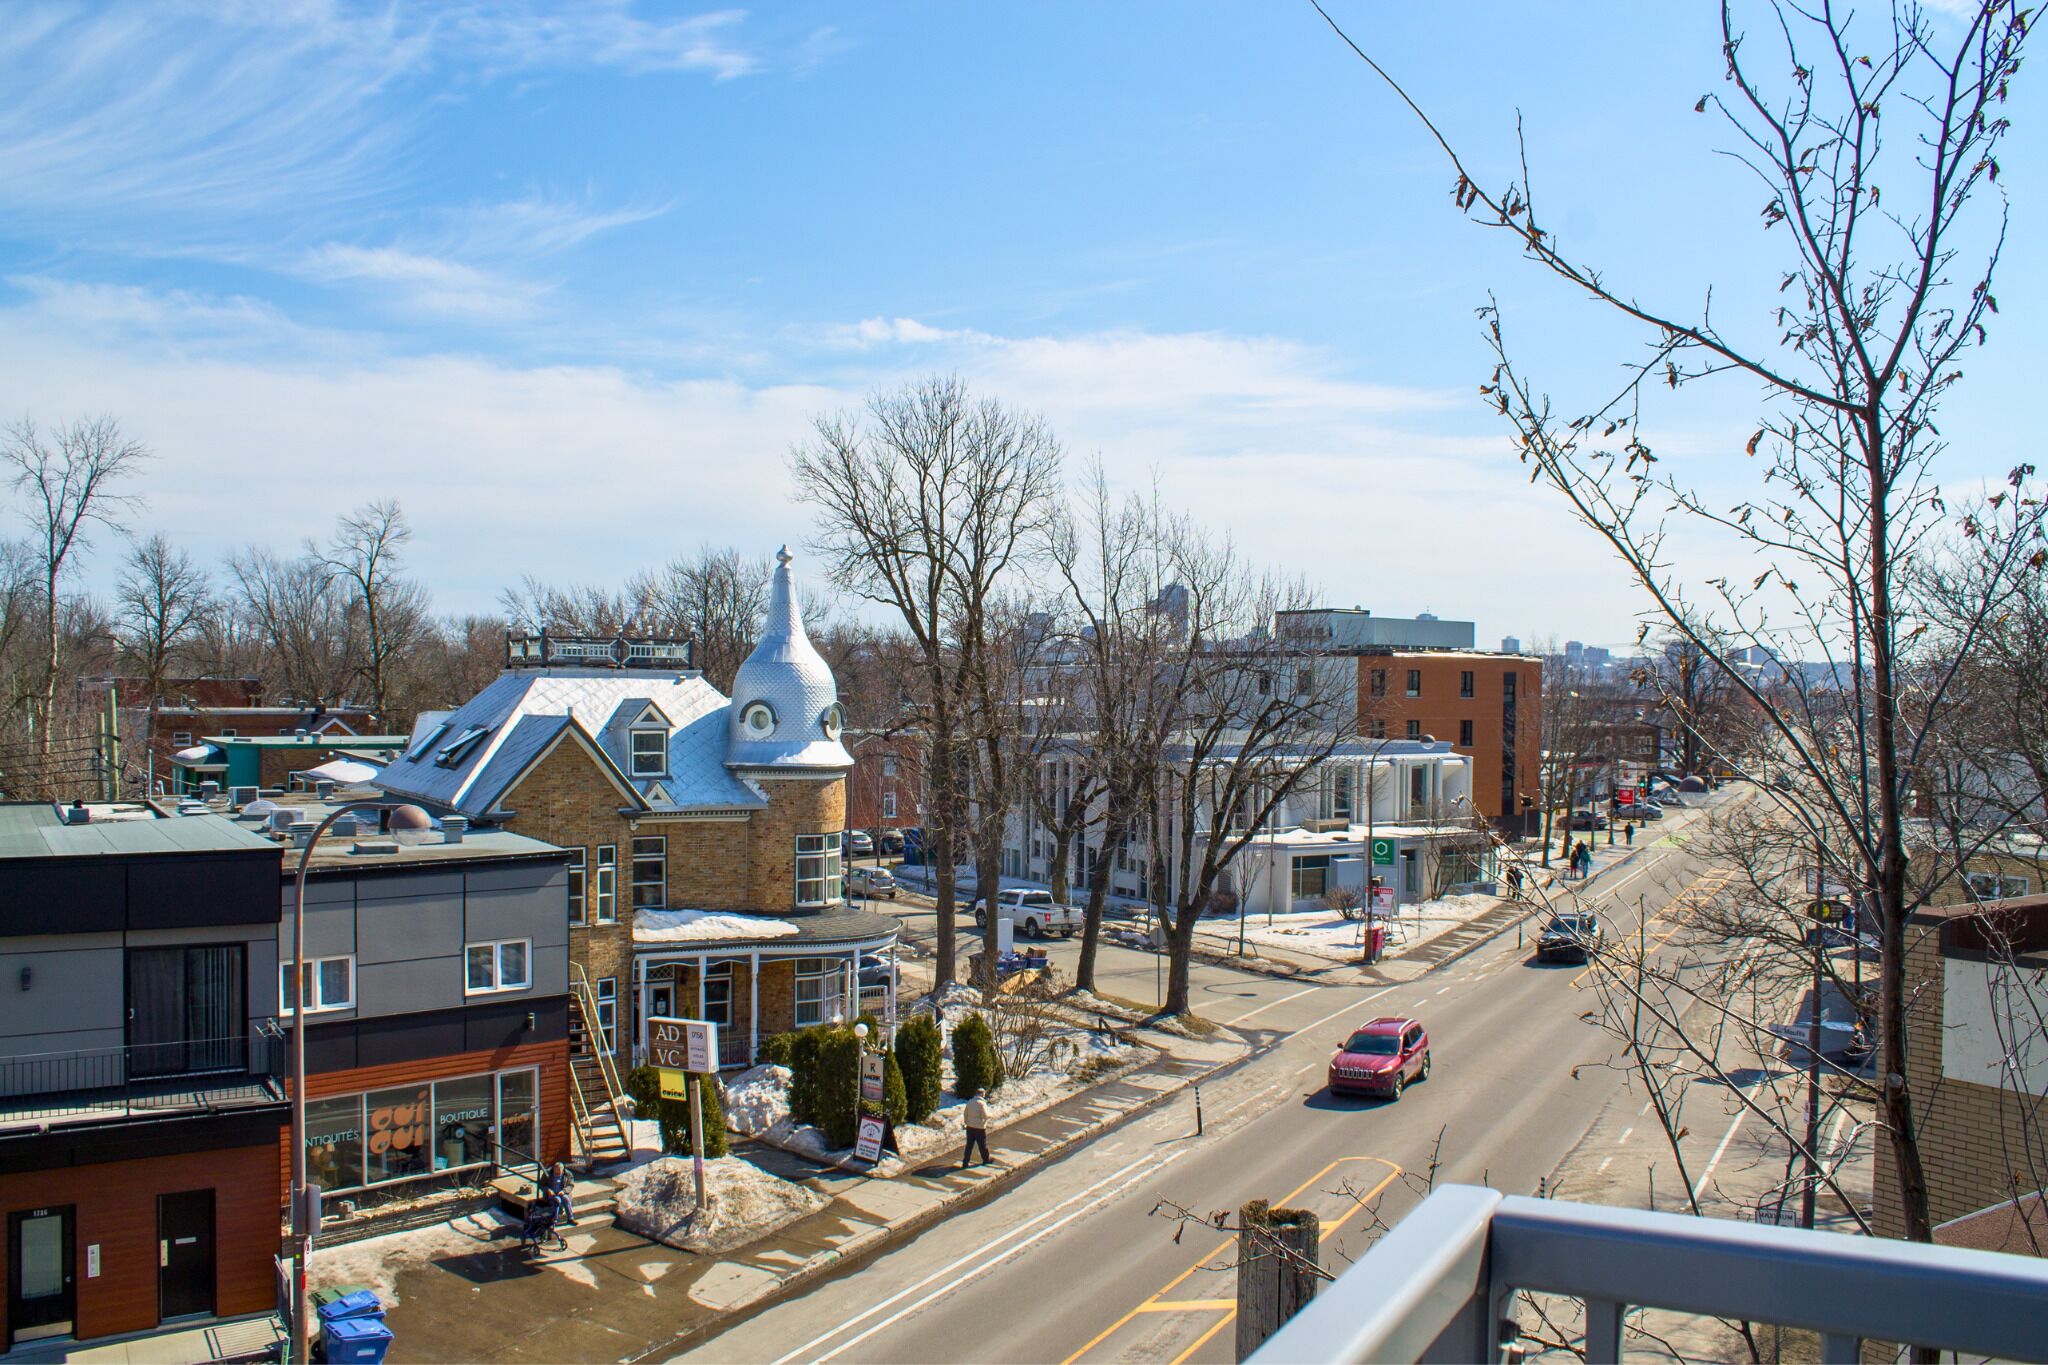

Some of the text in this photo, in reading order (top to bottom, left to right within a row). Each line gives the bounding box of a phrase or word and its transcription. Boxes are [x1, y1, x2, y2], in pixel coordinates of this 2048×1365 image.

[656, 1024, 680, 1042] AD
[656, 1048, 680, 1067] VC
[370, 1090, 428, 1130] oui
[440, 1107, 488, 1124] BOUTIQUE
[304, 1129, 360, 1147] NTIQUITÉS
[369, 1124, 424, 1154] oui
